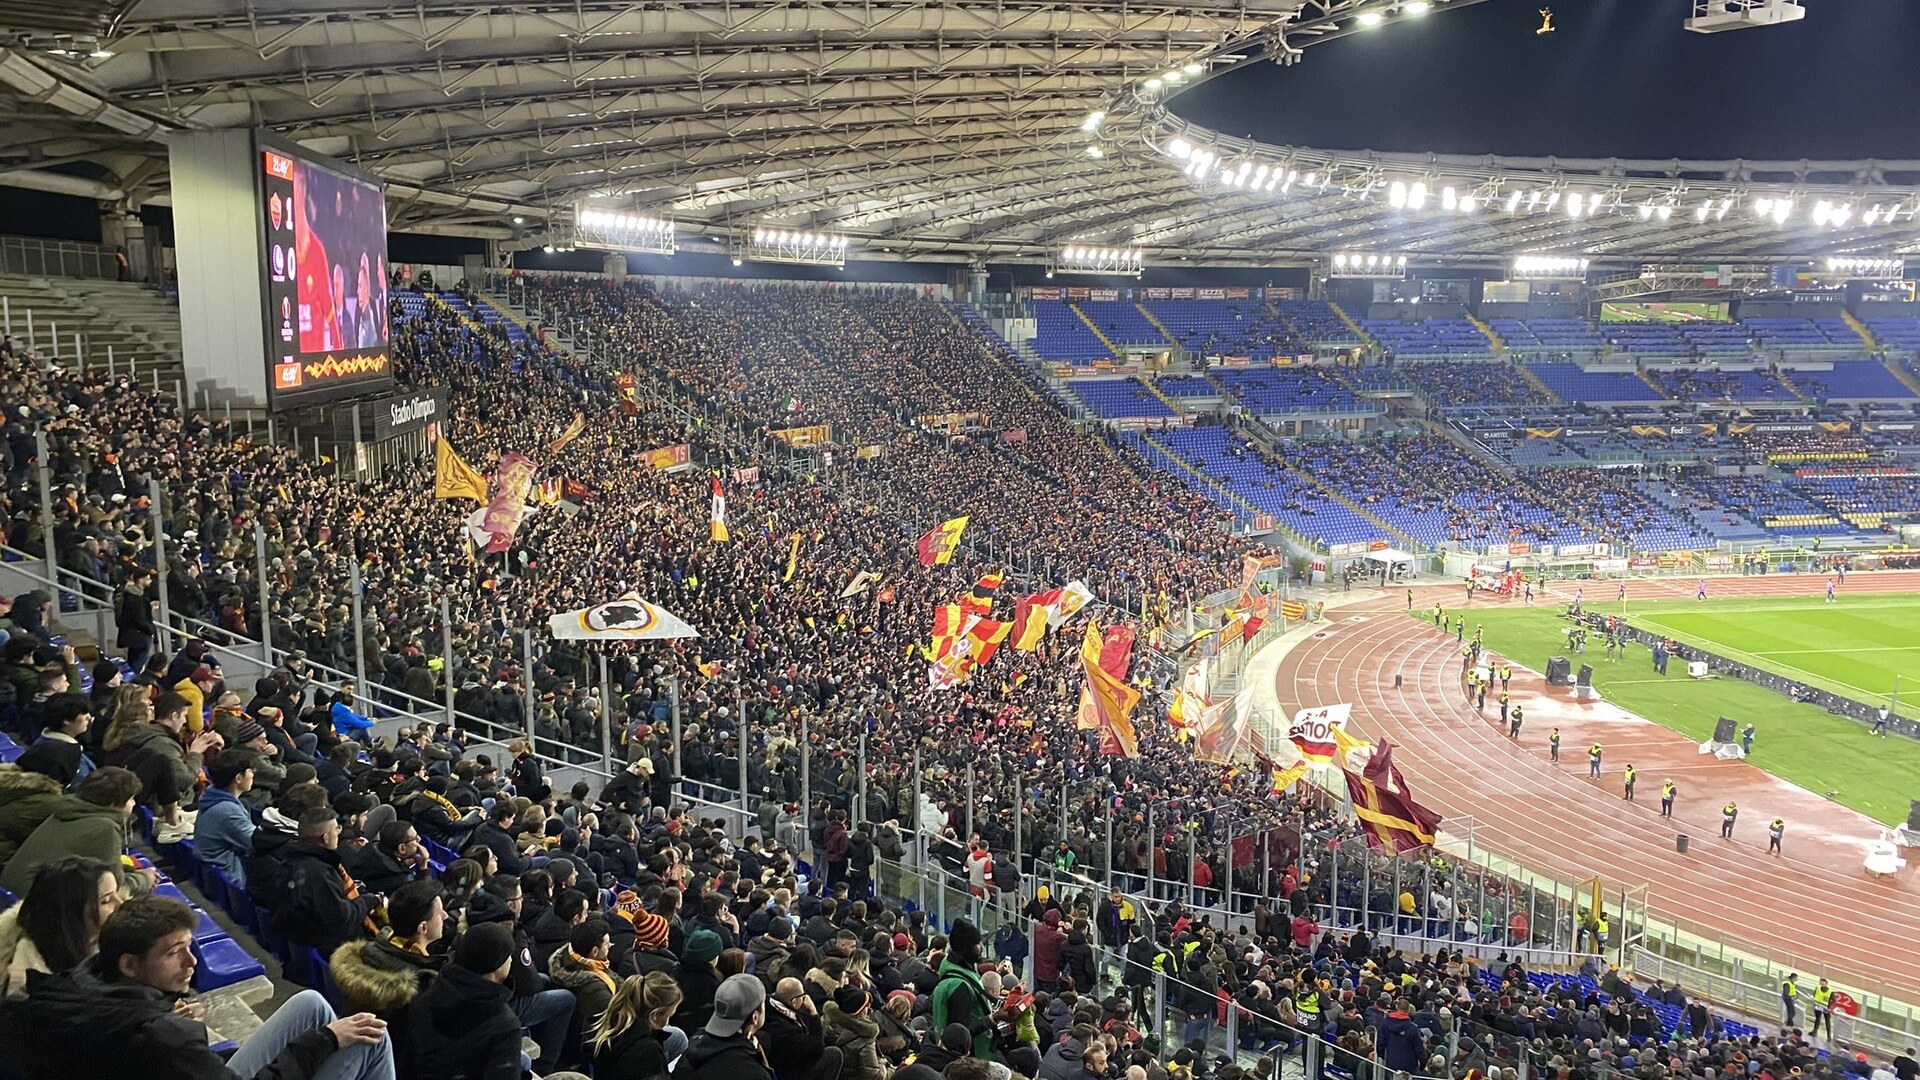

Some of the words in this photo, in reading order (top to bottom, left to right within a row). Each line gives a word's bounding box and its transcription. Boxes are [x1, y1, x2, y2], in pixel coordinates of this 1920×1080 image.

[286, 197, 293, 230] 1
[287, 247, 296, 281] 0
[391, 400, 410, 426] Stadio
[411, 394, 436, 421] Olimpico
